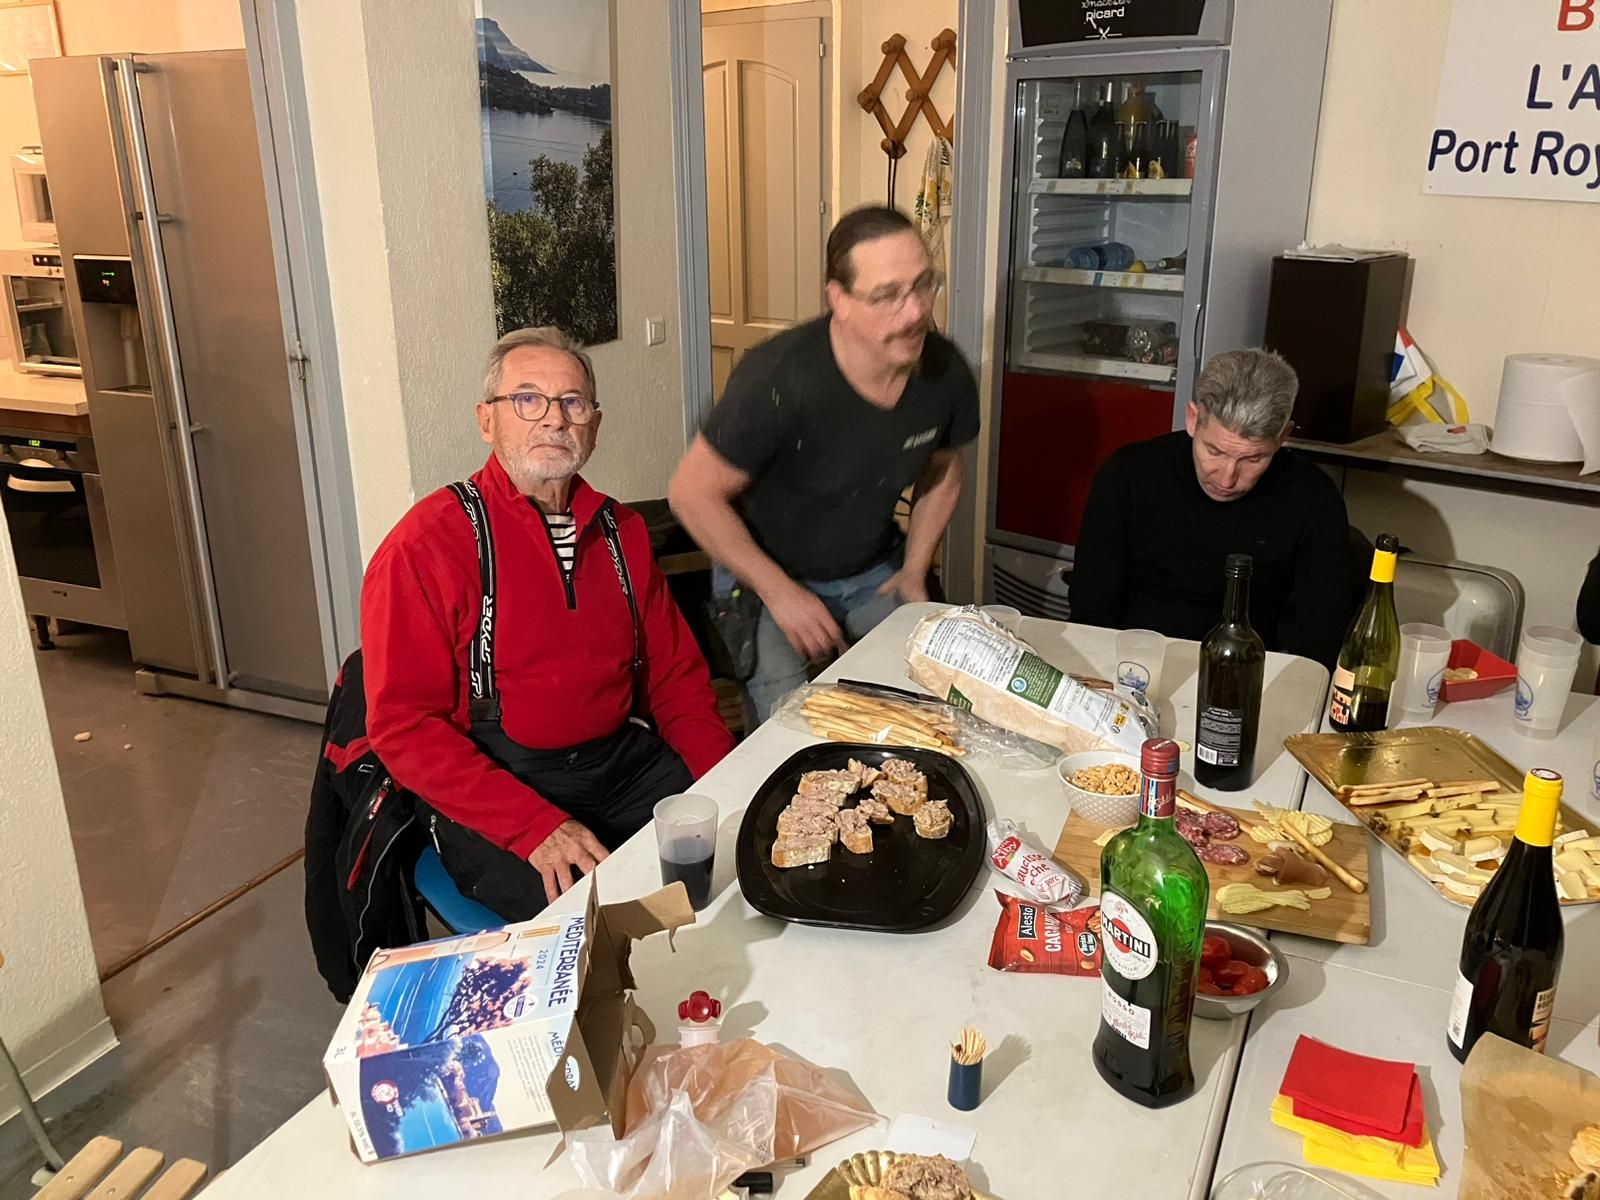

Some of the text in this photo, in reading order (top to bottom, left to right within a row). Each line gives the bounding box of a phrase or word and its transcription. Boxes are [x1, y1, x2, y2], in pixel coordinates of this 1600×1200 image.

[1085, 6, 1125, 29] Ricard
[1556, 0, 1600, 32] B
[1427, 129, 1519, 174] Port
[481, 595, 493, 664] SPYDER
[997, 840, 1018, 867] Alby
[1020, 907, 1033, 936] Alesto
[1102, 912, 1151, 959] MARTINI
[535, 949, 548, 970] 2024
